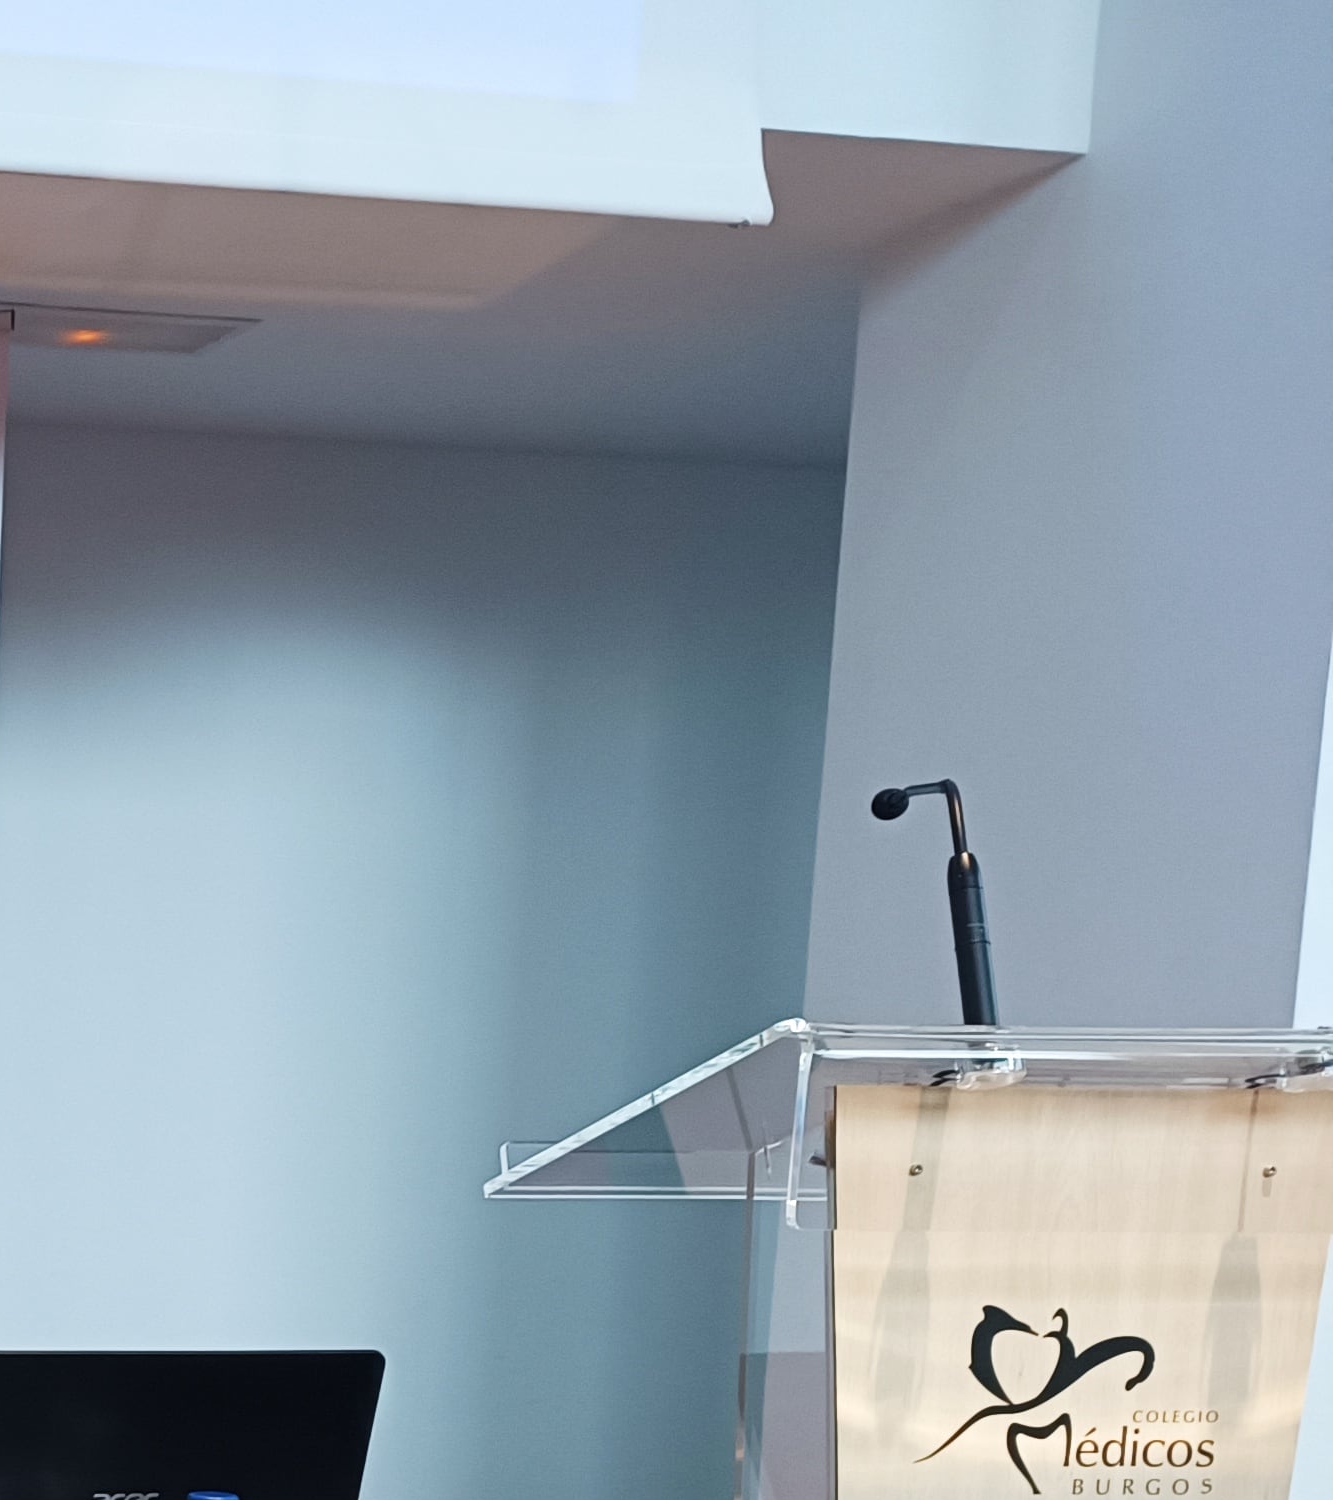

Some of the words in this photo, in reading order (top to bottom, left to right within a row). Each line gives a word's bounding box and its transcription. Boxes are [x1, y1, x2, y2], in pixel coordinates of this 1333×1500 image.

[1132, 1410, 1220, 1424] COLEGIO
[1006, 1412, 1215, 1495] Médicos
[1071, 1478, 1214, 1496] BURGOS
